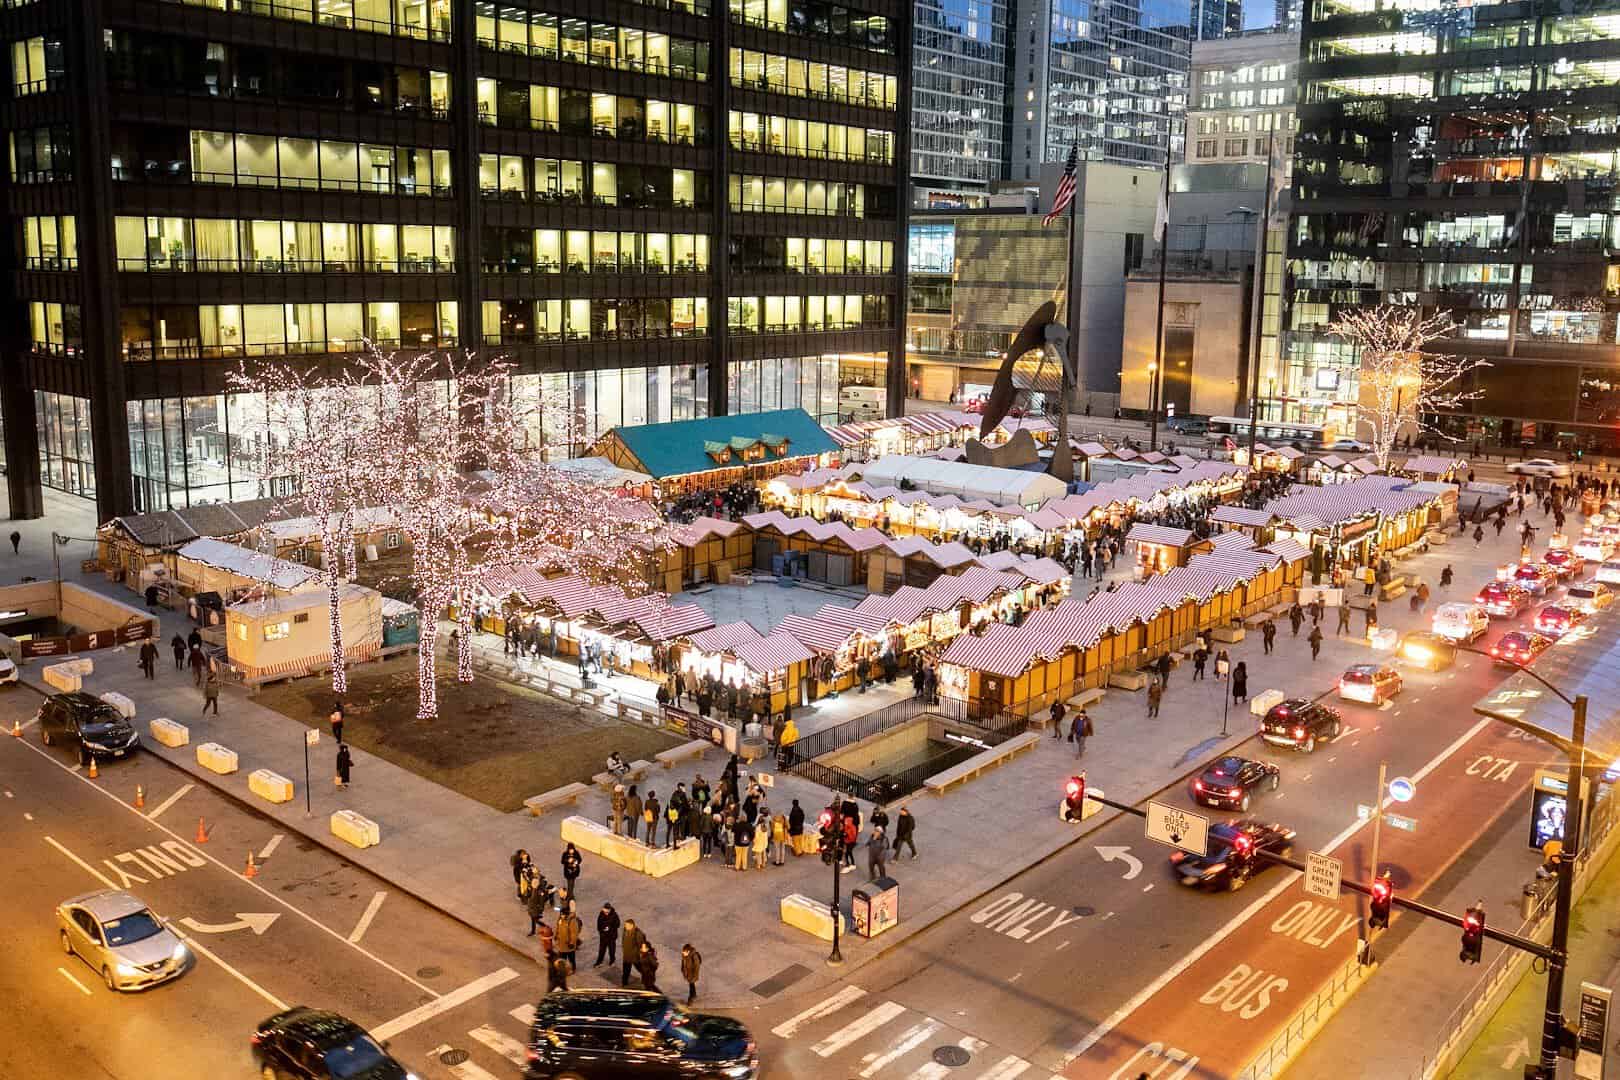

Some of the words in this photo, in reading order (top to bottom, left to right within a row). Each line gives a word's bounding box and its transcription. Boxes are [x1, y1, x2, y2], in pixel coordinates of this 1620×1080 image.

[1465, 755, 1520, 782] CTA
[1164, 815, 1190, 830] BUSES
[1169, 810, 1185, 821] CTA
[1165, 824, 1187, 837] ONLY
[103, 841, 207, 889] ONLY
[1309, 855, 1328, 867] RIGHT
[1330, 862, 1339, 870] ON
[1312, 866, 1334, 879] GREEN
[1312, 875, 1334, 888] ARROW
[1312, 884, 1330, 896] ONLY
[970, 892, 1083, 943] ONLY
[1271, 901, 1363, 949] ONLY
[1199, 963, 1289, 1019] BUS
